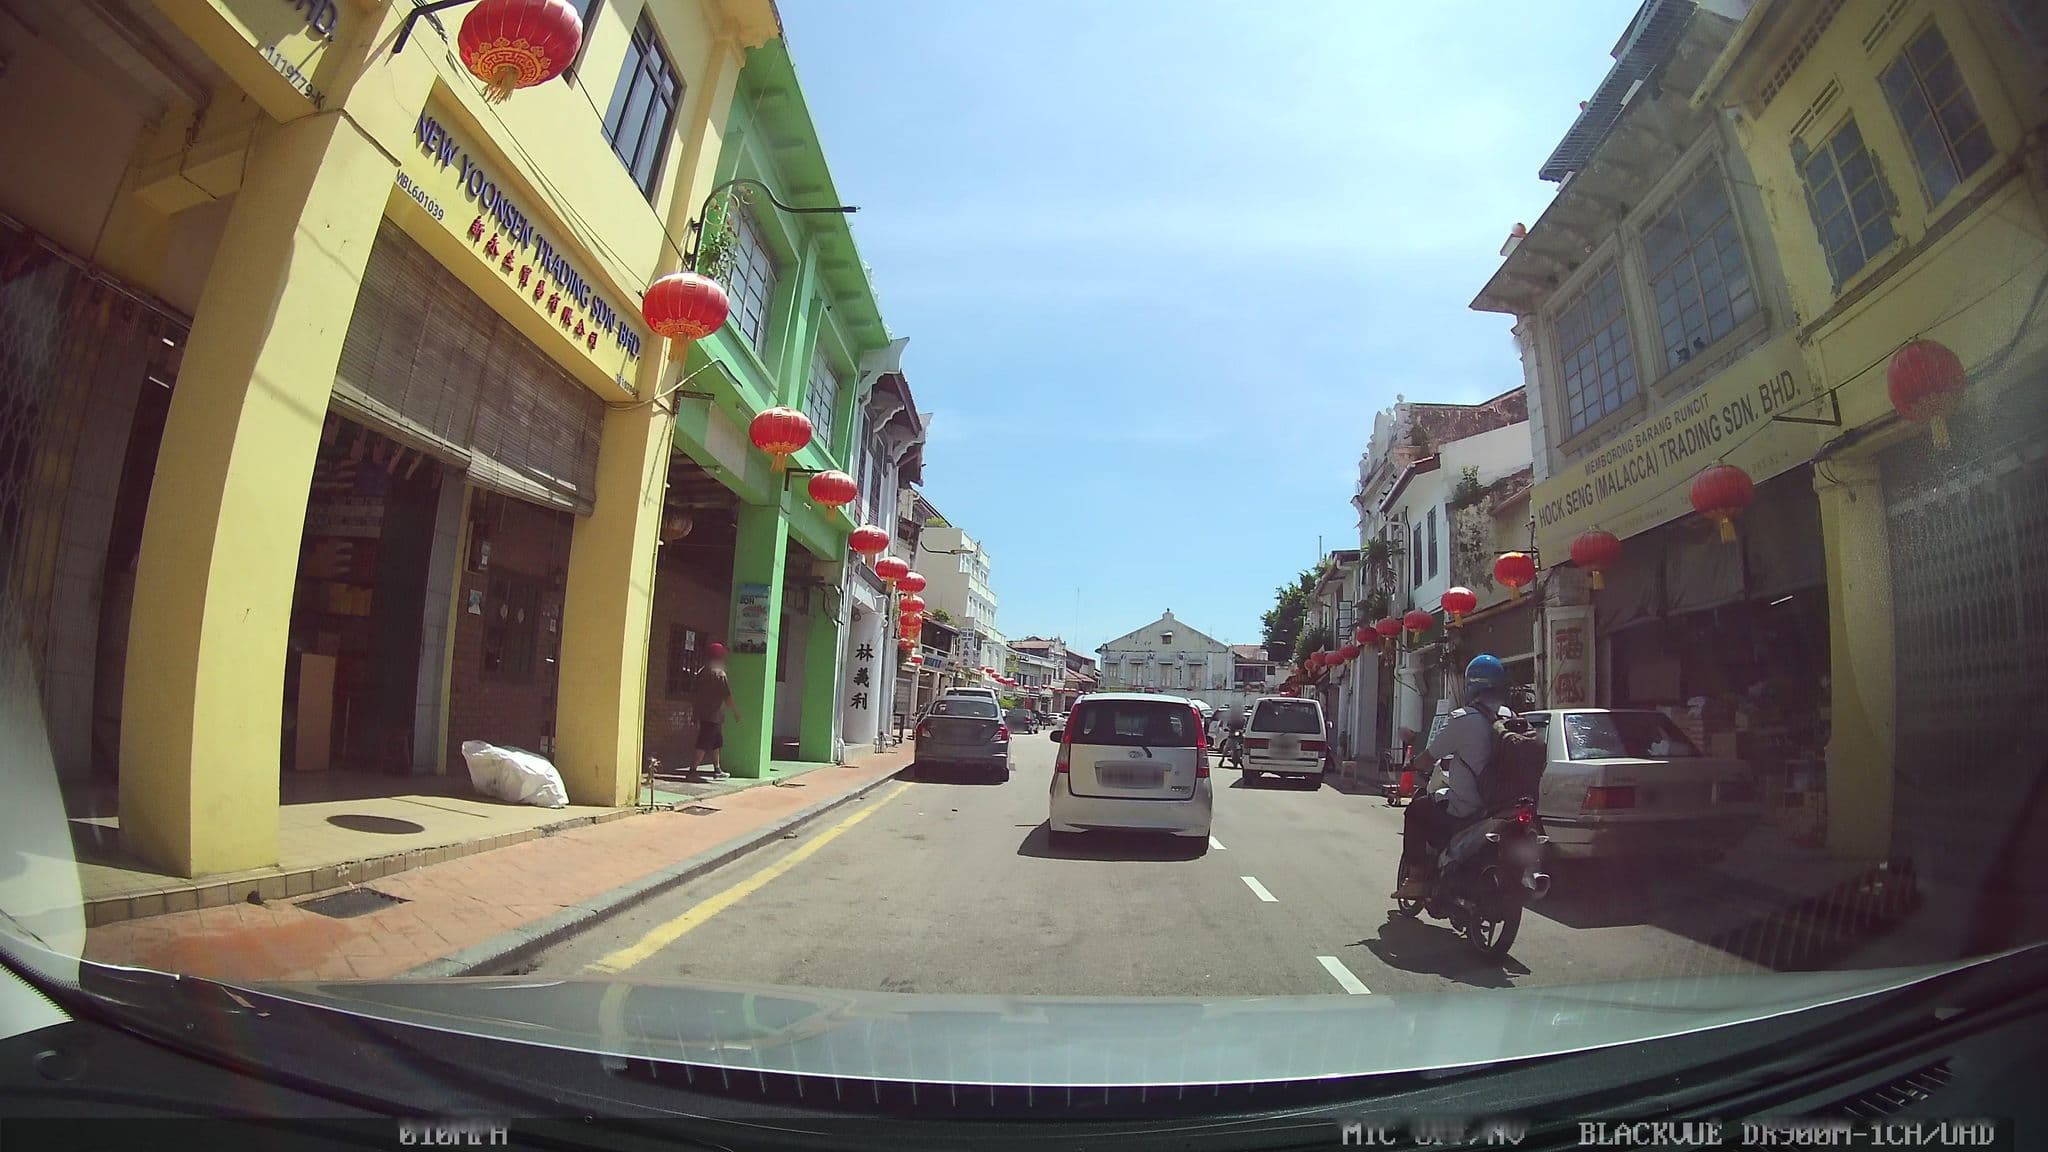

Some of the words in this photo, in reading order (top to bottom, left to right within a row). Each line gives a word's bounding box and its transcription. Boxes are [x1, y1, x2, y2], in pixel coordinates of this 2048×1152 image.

[268, 46, 325, 109] 1119779-K
[414, 111, 460, 167] NEW
[459, 154, 534, 250] YOONSEN
[535, 234, 592, 309] TRADING
[1538, 496, 1565, 528] HOCK
[1565, 483, 1593, 516] SENG
[1594, 453, 1660, 503] (MALACCA)
[1660, 418, 1723, 468] TRADING
[1723, 394, 1759, 437] SDN.
[1759, 369, 1801, 415] BHD.
[1584, 440, 1634, 476] MEMBORONG
[1635, 416, 1673, 449] BARANG
[1673, 392, 1710, 424] RUNCIT
[850, 643, 874, 710] 林義利
